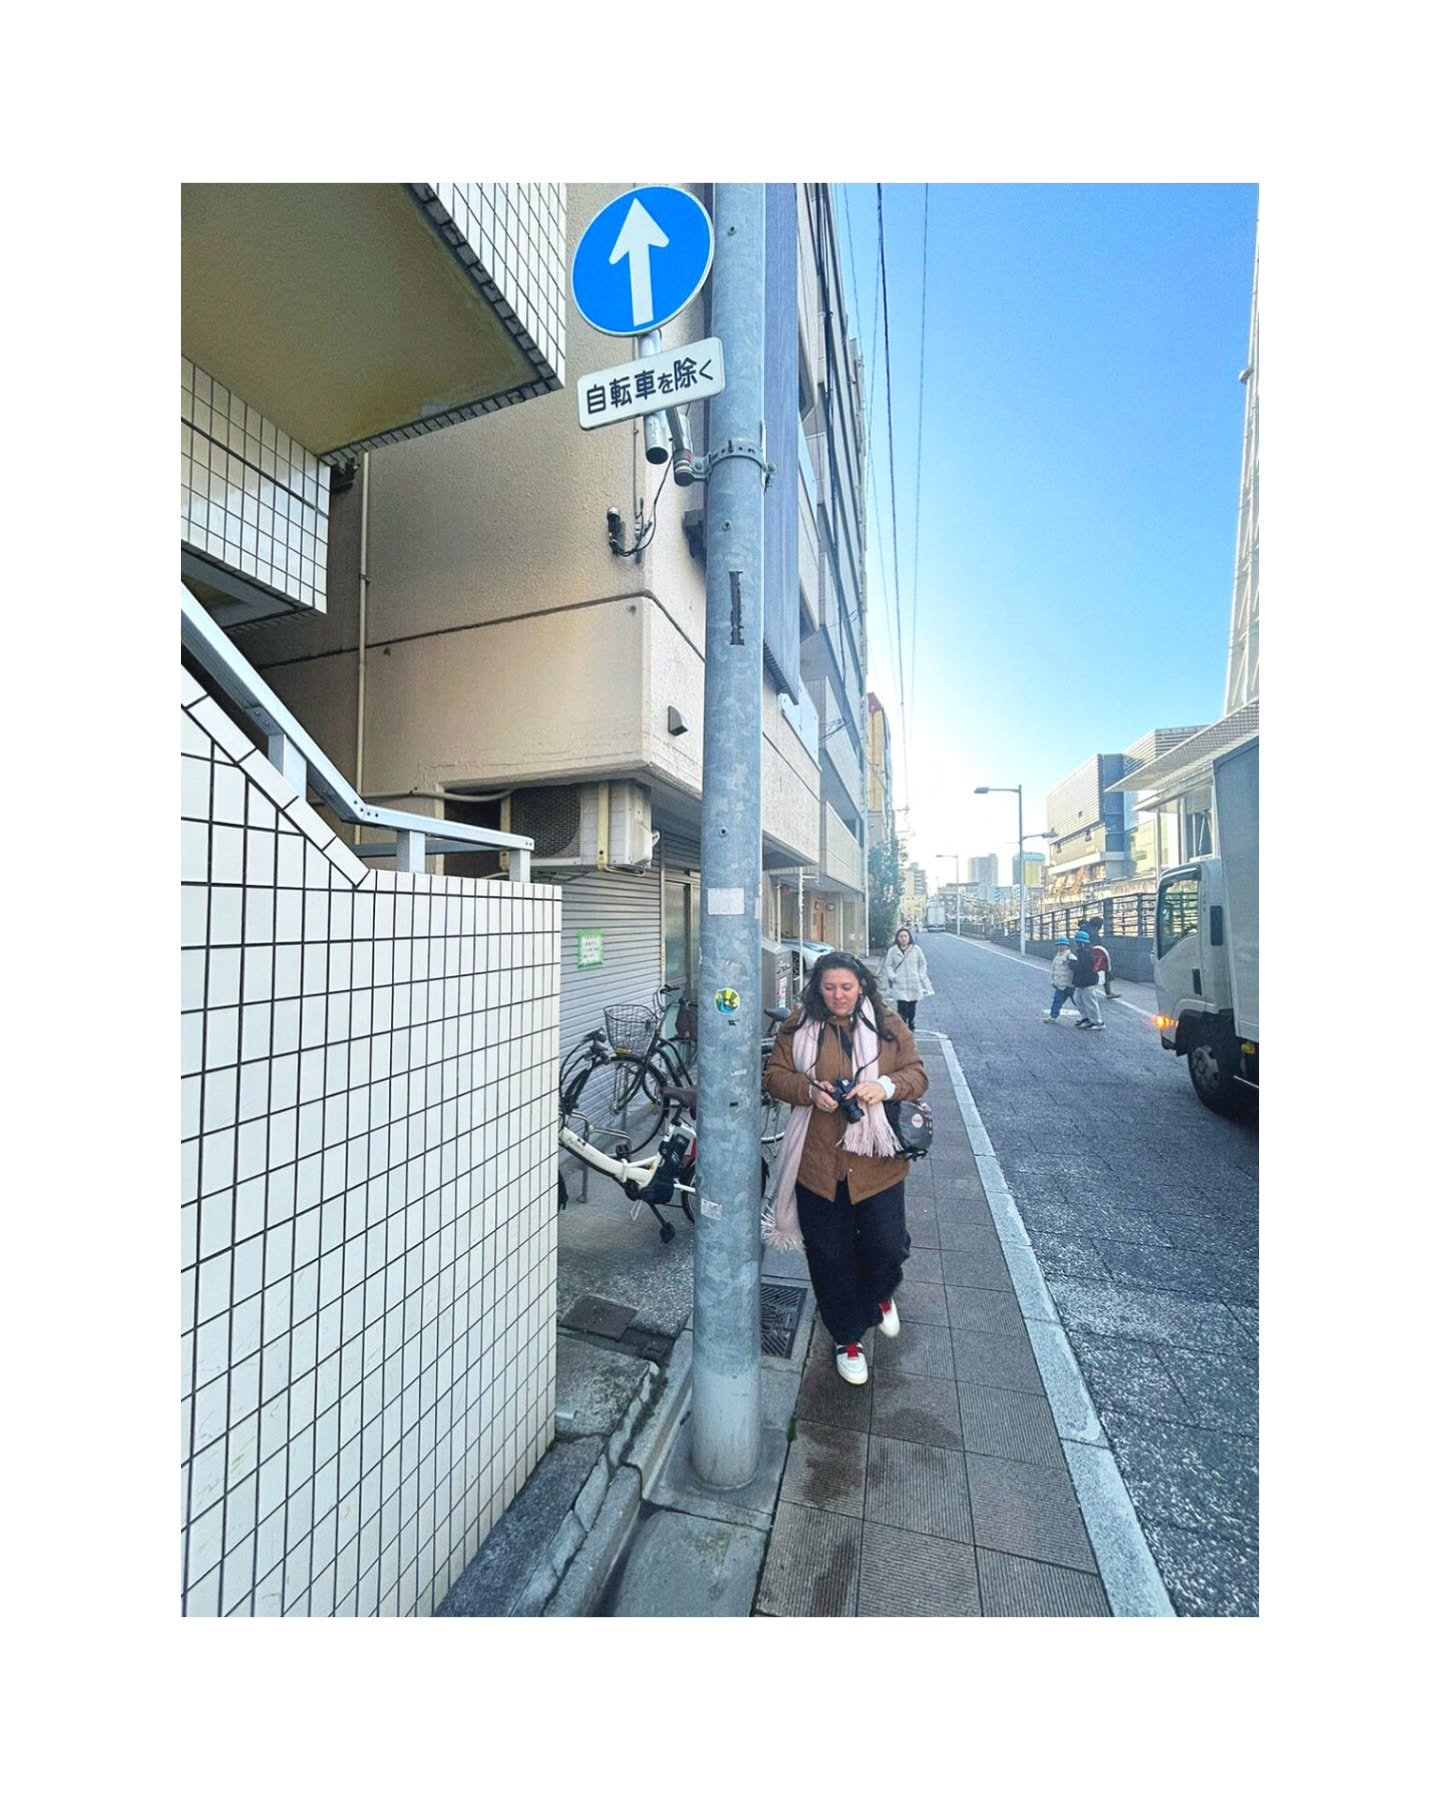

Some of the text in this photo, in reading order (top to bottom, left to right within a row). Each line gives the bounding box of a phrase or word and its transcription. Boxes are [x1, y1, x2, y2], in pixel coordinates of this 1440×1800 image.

[587, 357, 713, 414] 自転車を除く
